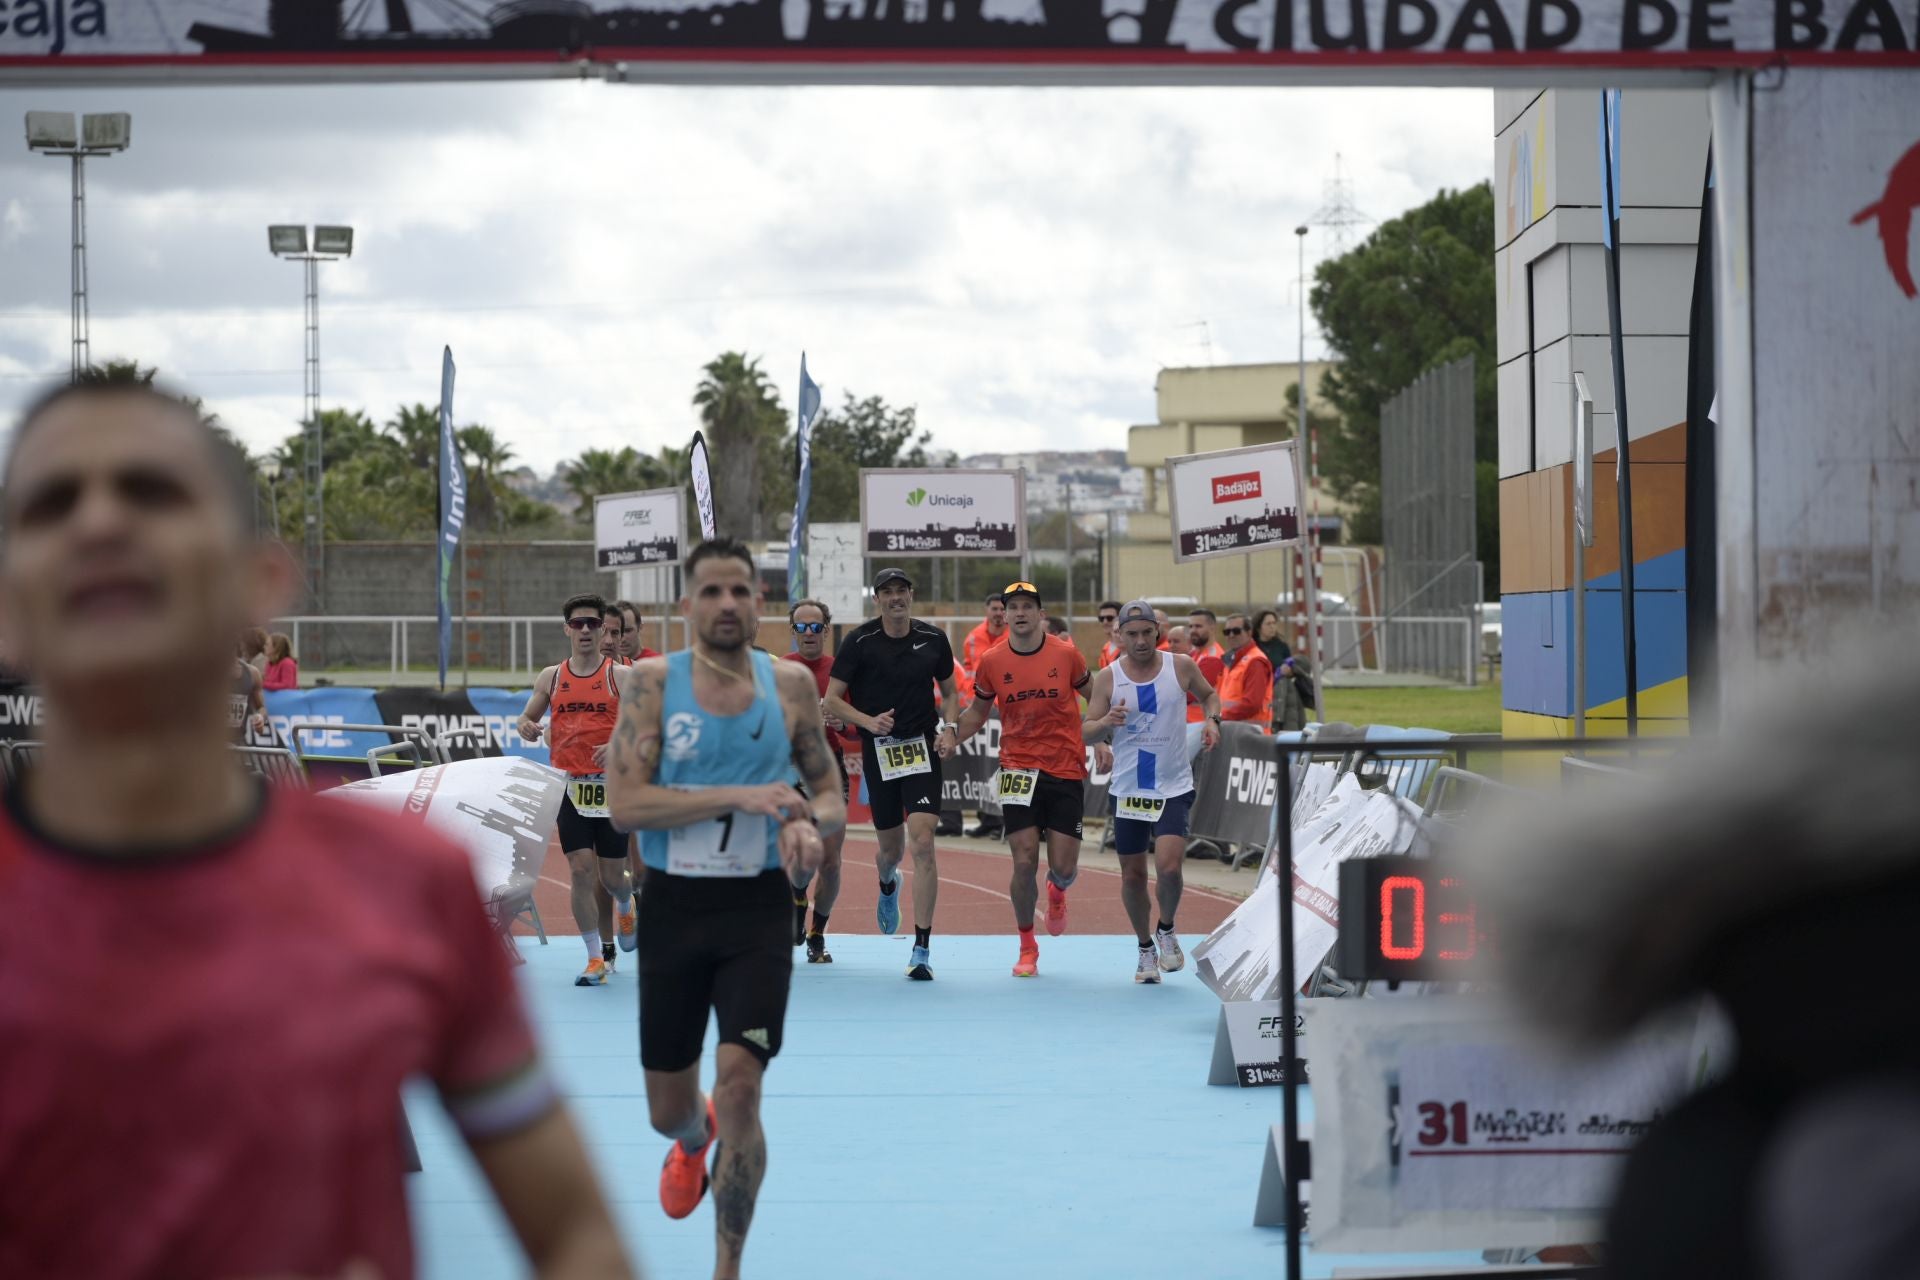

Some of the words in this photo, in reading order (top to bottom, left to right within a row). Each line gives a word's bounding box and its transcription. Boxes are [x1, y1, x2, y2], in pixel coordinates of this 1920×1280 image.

[0, 0, 106, 55] aja
[1213, 0, 1581, 51] CIUDAD
[1621, 0, 1735, 51] DE
[1774, 0, 1920, 51] BA
[1215, 480, 1259, 498] Badajoz
[929, 494, 974, 509] Unicaja
[887, 534, 905, 550] 31
[954, 533, 965, 548] 9
[1248, 525, 1257, 542] 9
[1195, 533, 1210, 553] 31
[1005, 688, 1058, 704] ASFAS
[557, 702, 607, 713] ASFAS
[885, 742, 926, 767] 1594
[1000, 773, 1033, 795] 1063
[578, 783, 607, 806] 108
[1246, 1068, 1264, 1084] 31
[1417, 1101, 1469, 1146] 31
